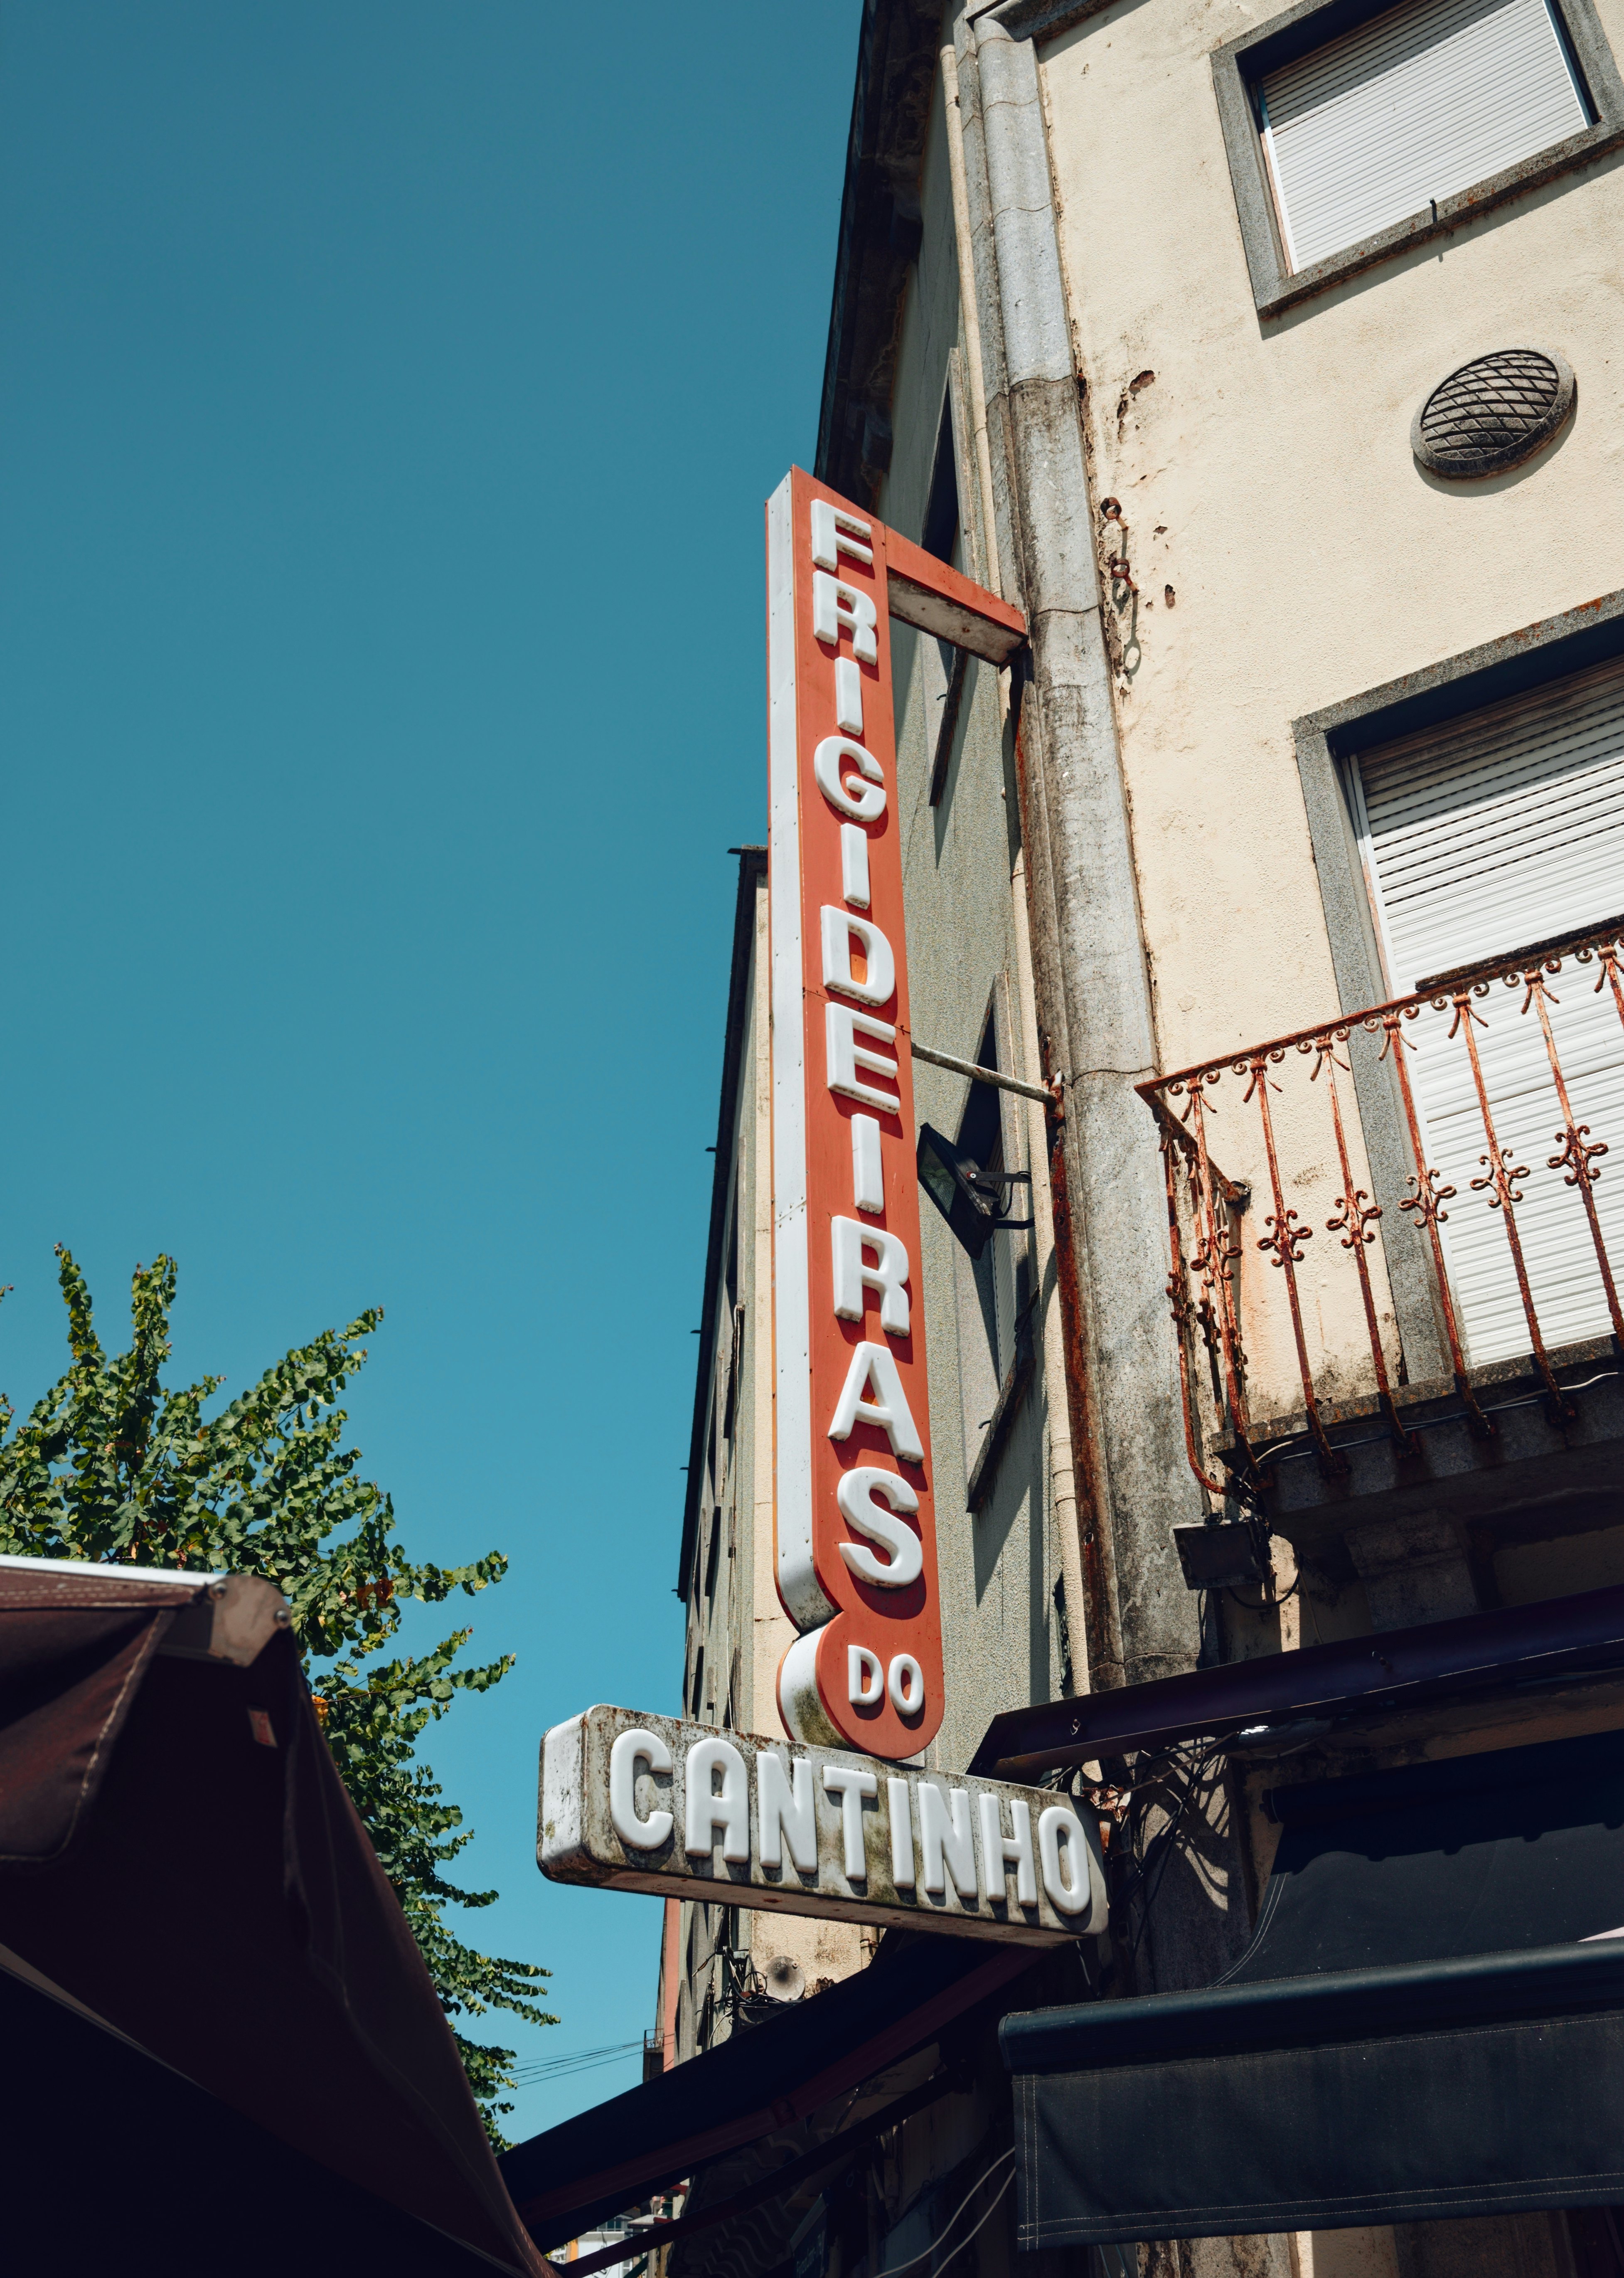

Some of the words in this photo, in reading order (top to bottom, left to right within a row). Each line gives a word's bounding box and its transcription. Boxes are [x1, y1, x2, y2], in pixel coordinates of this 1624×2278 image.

[811, 498, 924, 1589] FRIGIDEIRAS
[848, 1645, 924, 1716] DO
[610, 1727, 1090, 1914] CANTINHO
